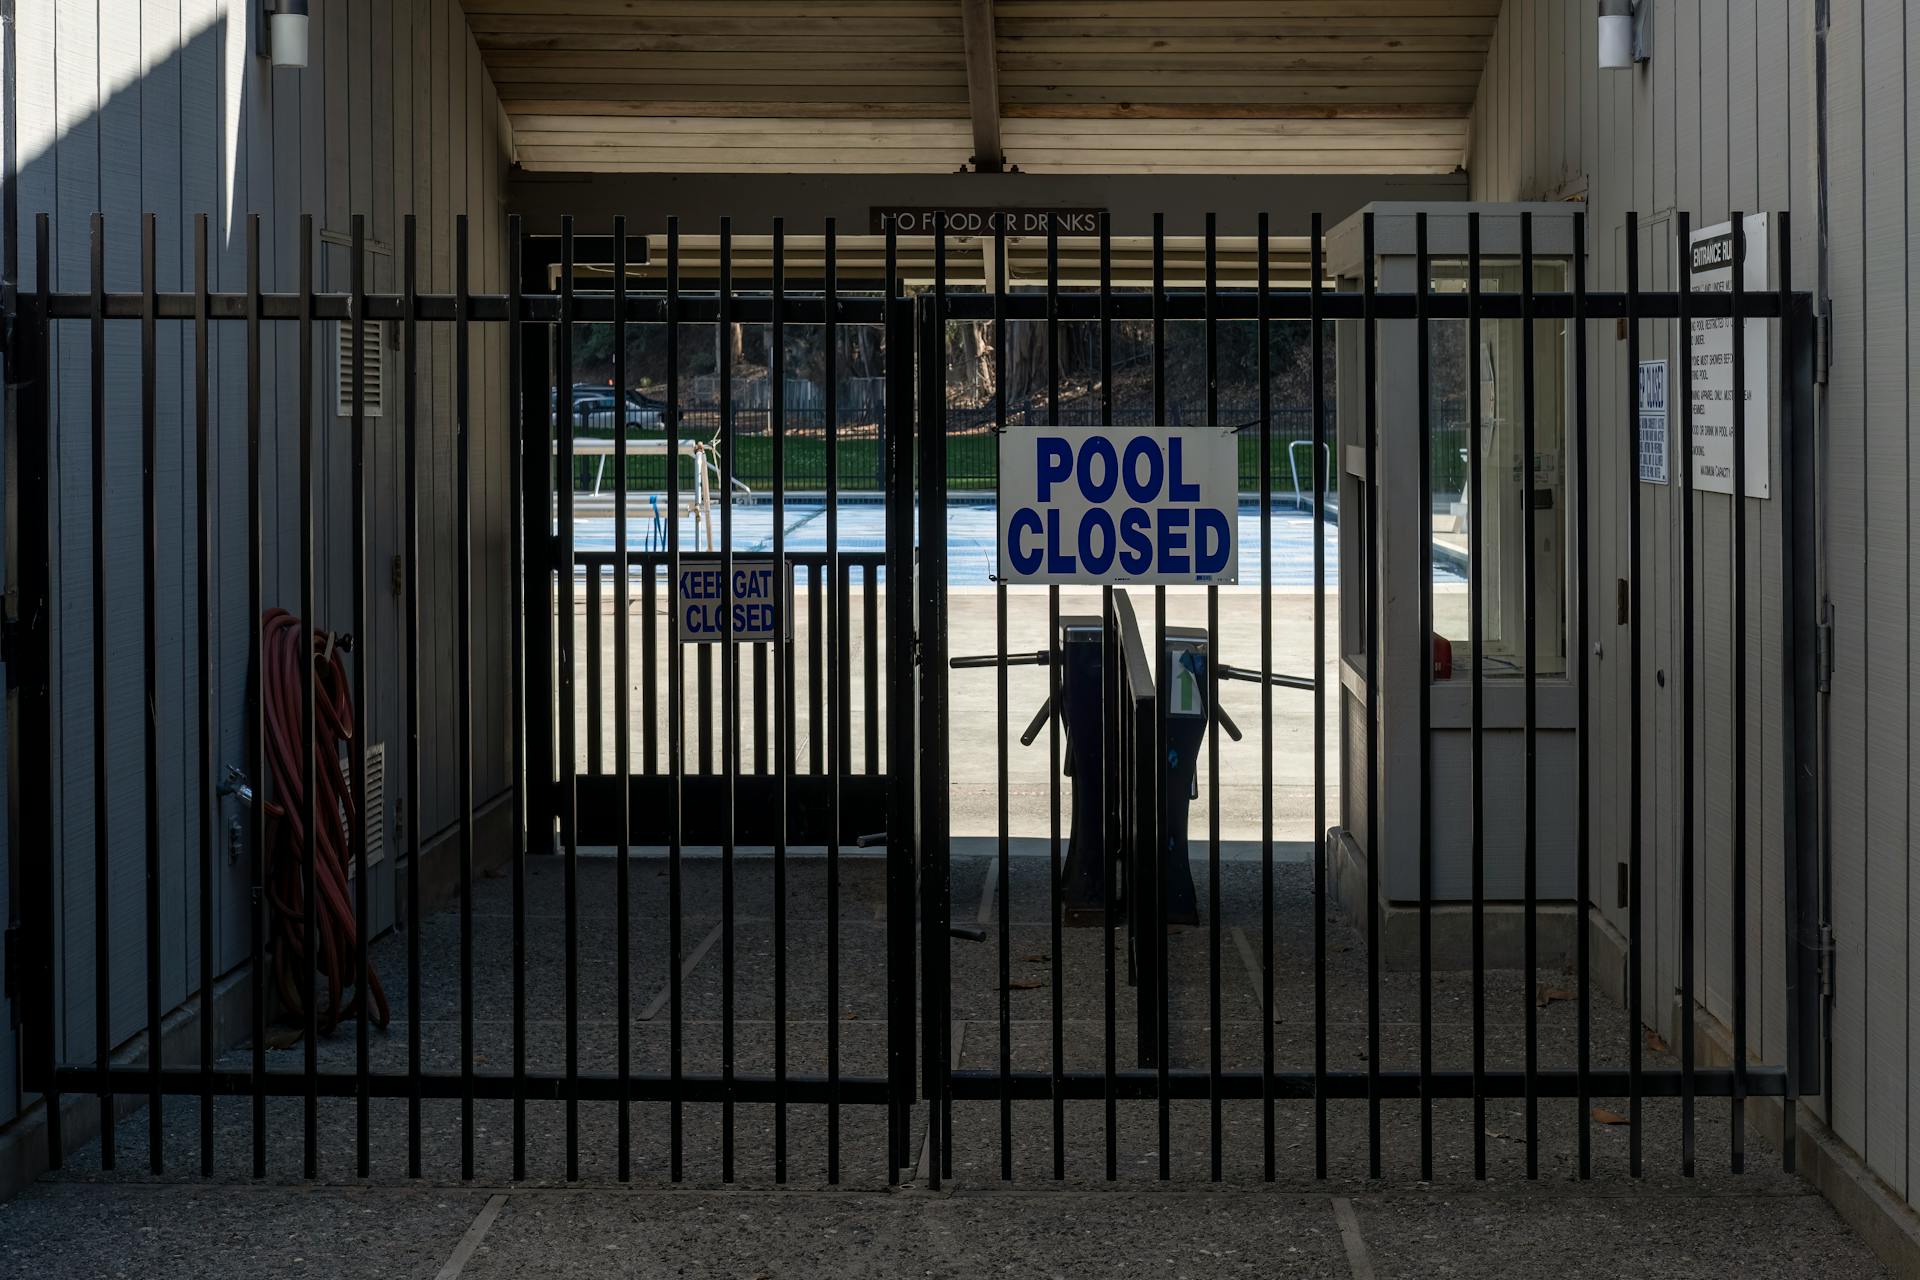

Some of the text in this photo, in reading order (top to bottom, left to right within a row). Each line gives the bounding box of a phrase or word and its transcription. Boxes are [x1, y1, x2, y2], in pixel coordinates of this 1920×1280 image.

[880, 212, 916, 231] NO
[1024, 213, 1096, 232] DRNKS
[1693, 243, 1722, 267] ENTRANCE
[1036, 435, 1201, 504] POOL
[1007, 507, 1231, 576] CLOSED
[733, 570, 774, 599] GAT
